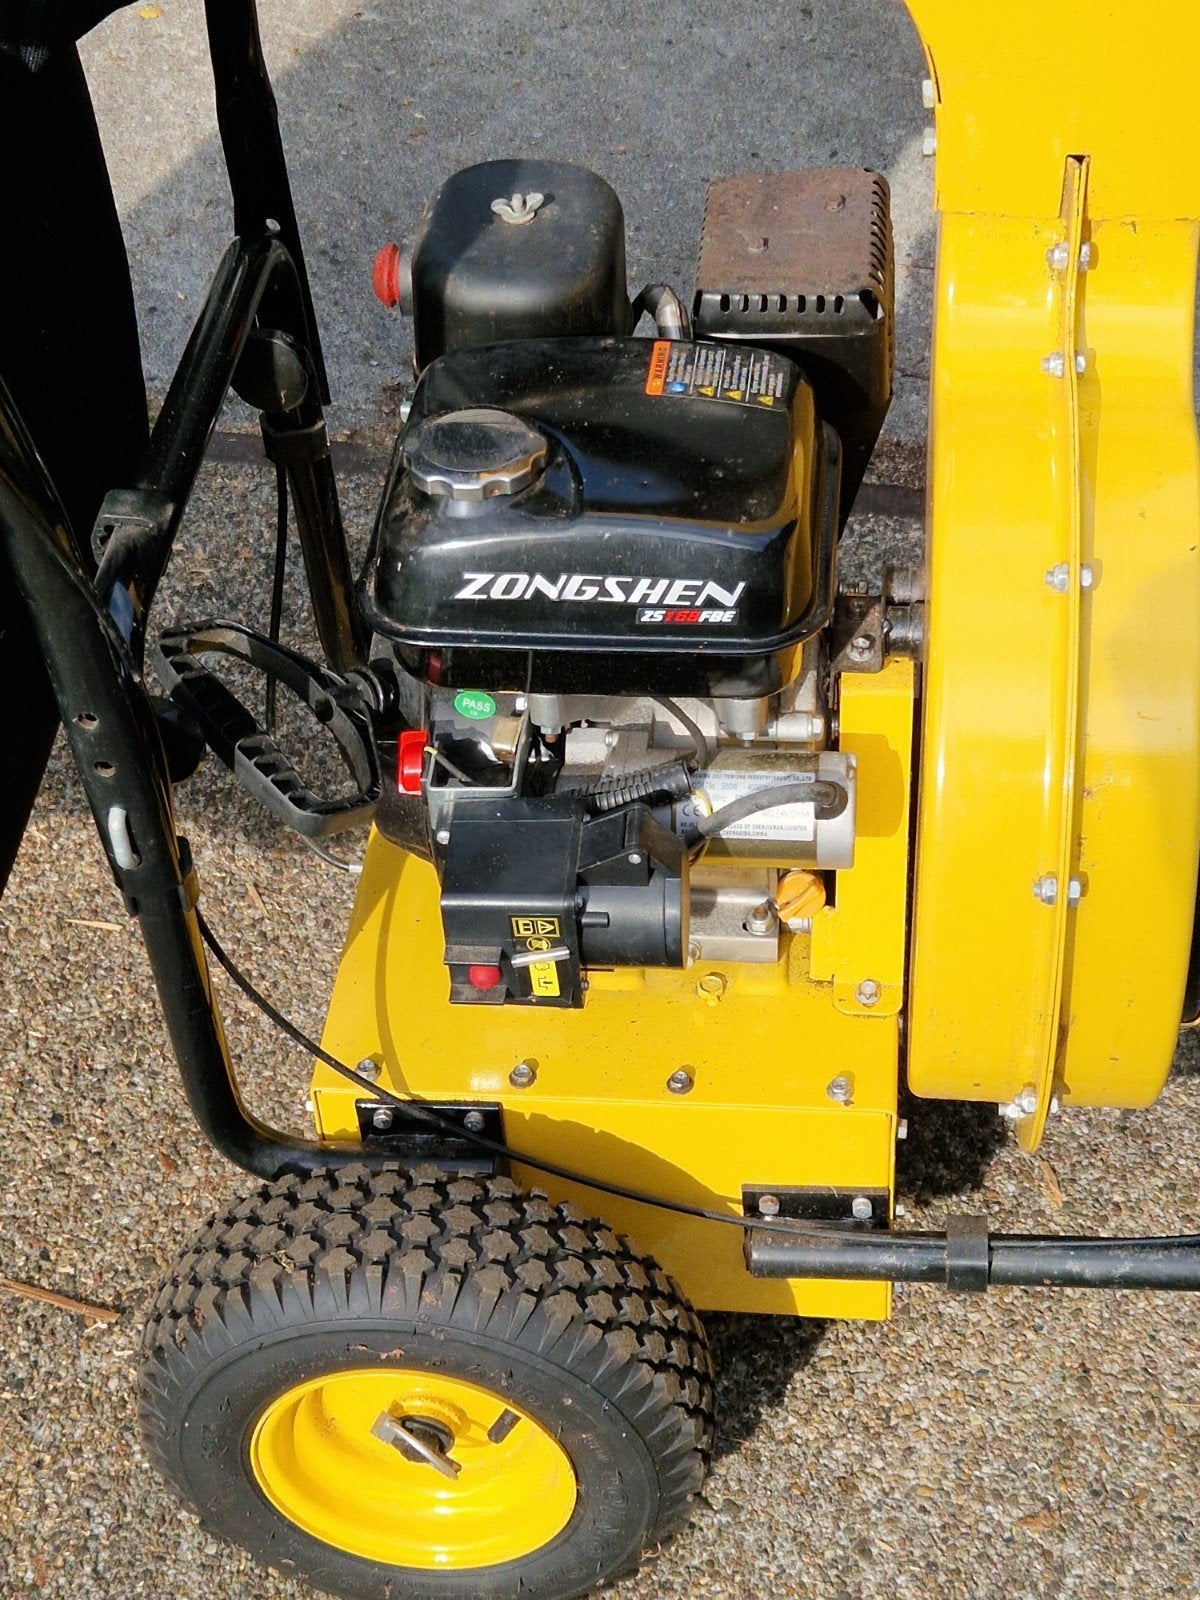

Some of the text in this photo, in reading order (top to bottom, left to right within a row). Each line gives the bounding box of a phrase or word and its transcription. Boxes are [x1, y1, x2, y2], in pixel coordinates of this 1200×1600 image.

[658, 347, 668, 380] WARNING
[454, 572, 746, 607] ZONGSHEN
[462, 698, 491, 712] PASS
[682, 804, 700, 817] CE
